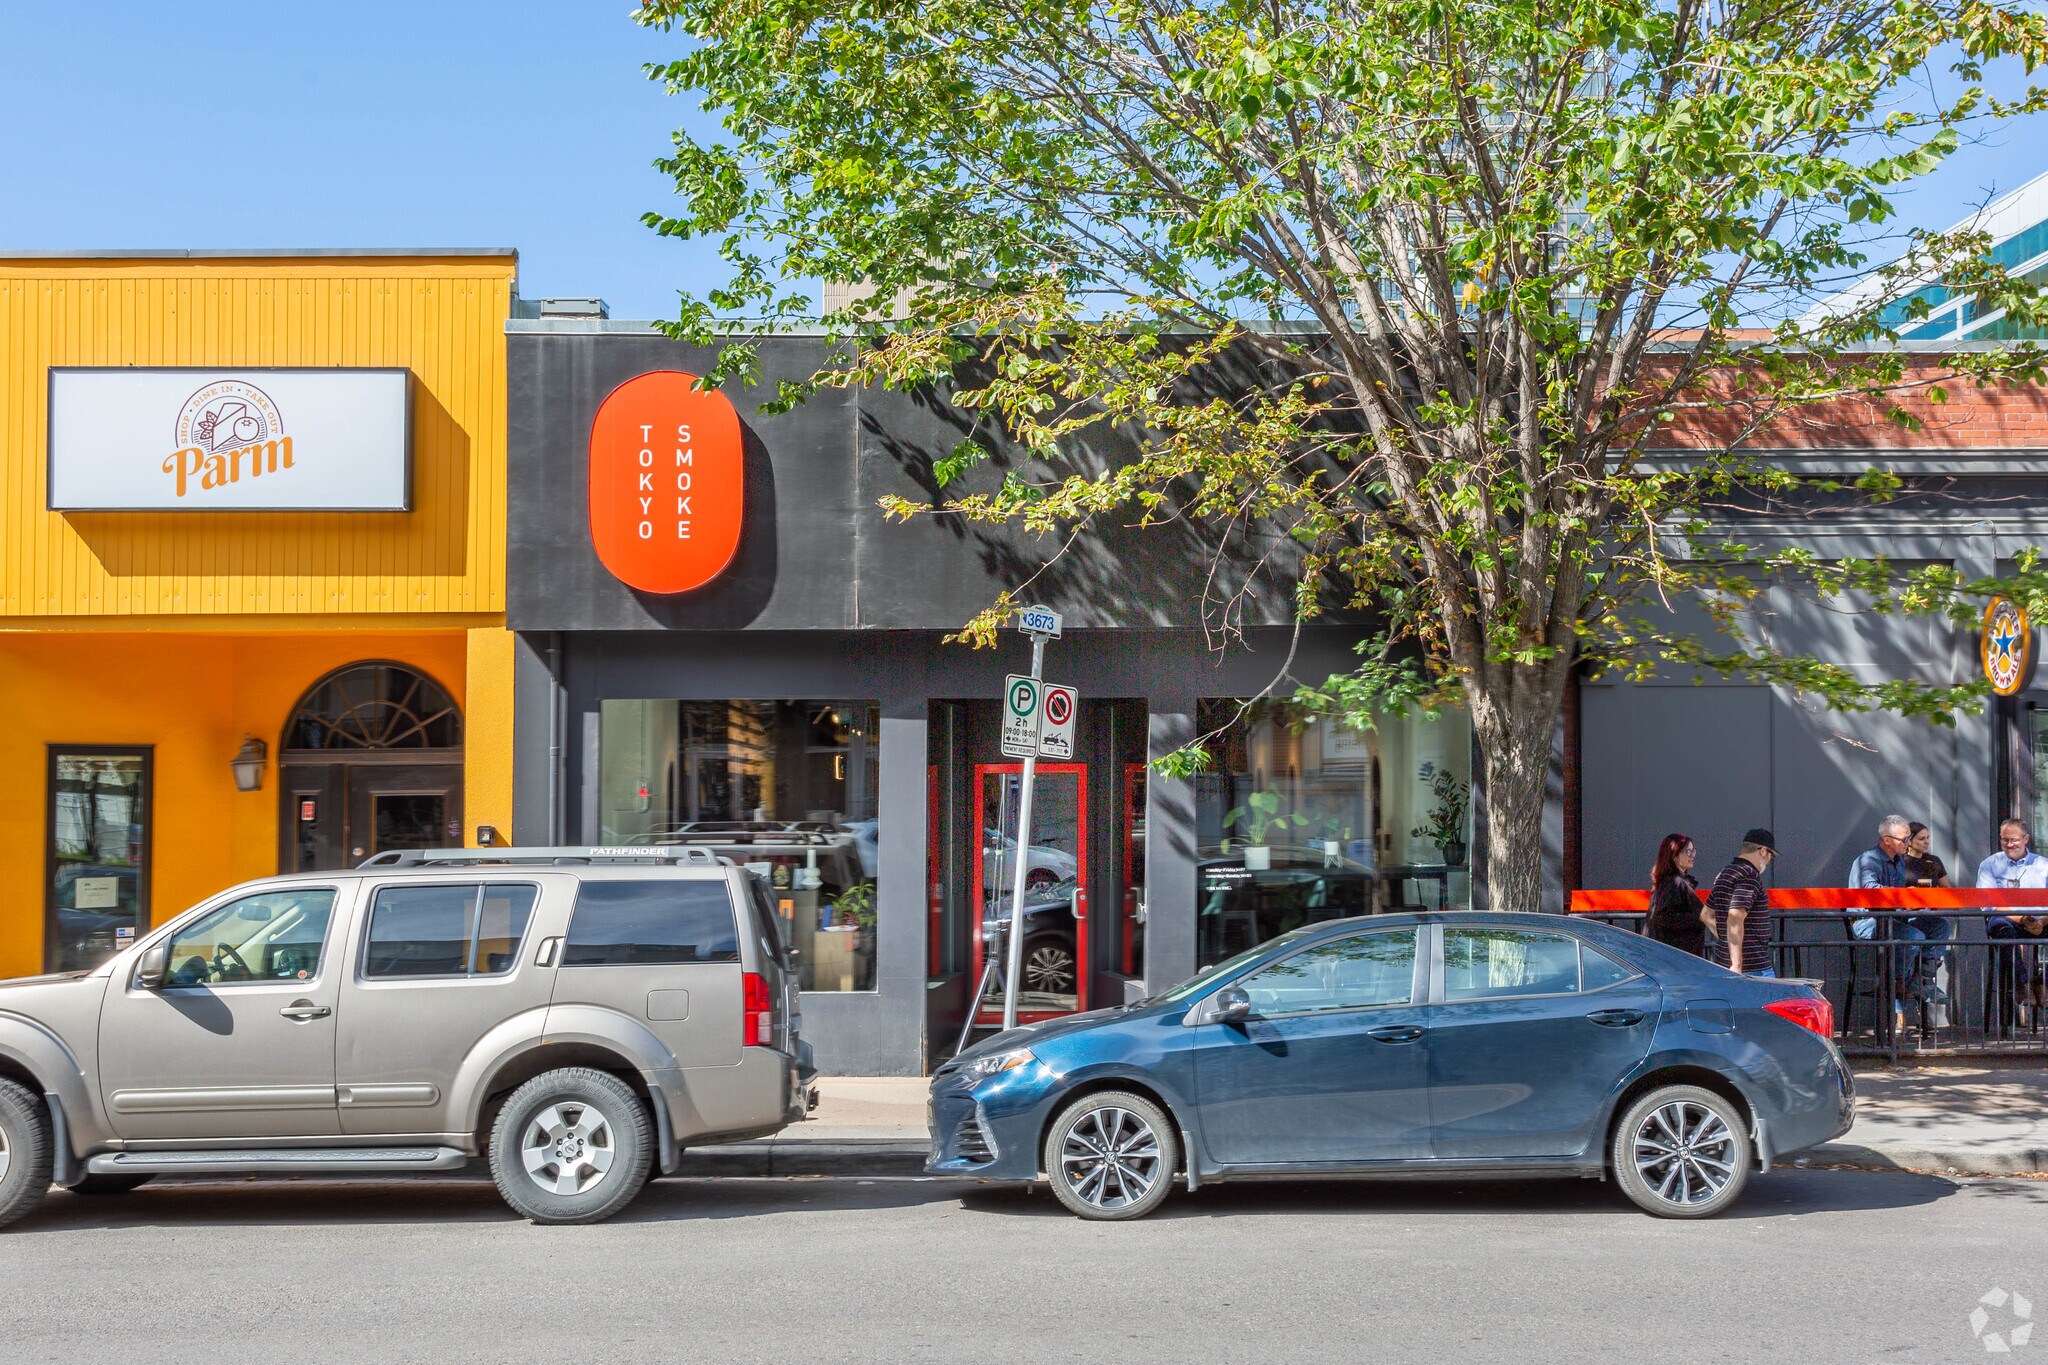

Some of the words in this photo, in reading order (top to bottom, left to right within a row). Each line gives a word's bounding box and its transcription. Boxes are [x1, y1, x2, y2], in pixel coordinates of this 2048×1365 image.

[180, 415, 190, 444] SHOP
[192, 388, 218, 408] DINE
[221, 385, 233, 393] IN
[245, 389, 269, 410] TAKE
[267, 411, 278, 434] OUT
[162, 436, 296, 497] Parm
[638, 425, 654, 539] TOKYO
[676, 424, 693, 539] SMOKE
[1027, 612, 1055, 630] 3673
[1990, 657, 2011, 685] BROWN
[2010, 655, 2021, 678] ALE
[1017, 687, 1031, 708] P
[589, 847, 666, 855] PATHFINDER
